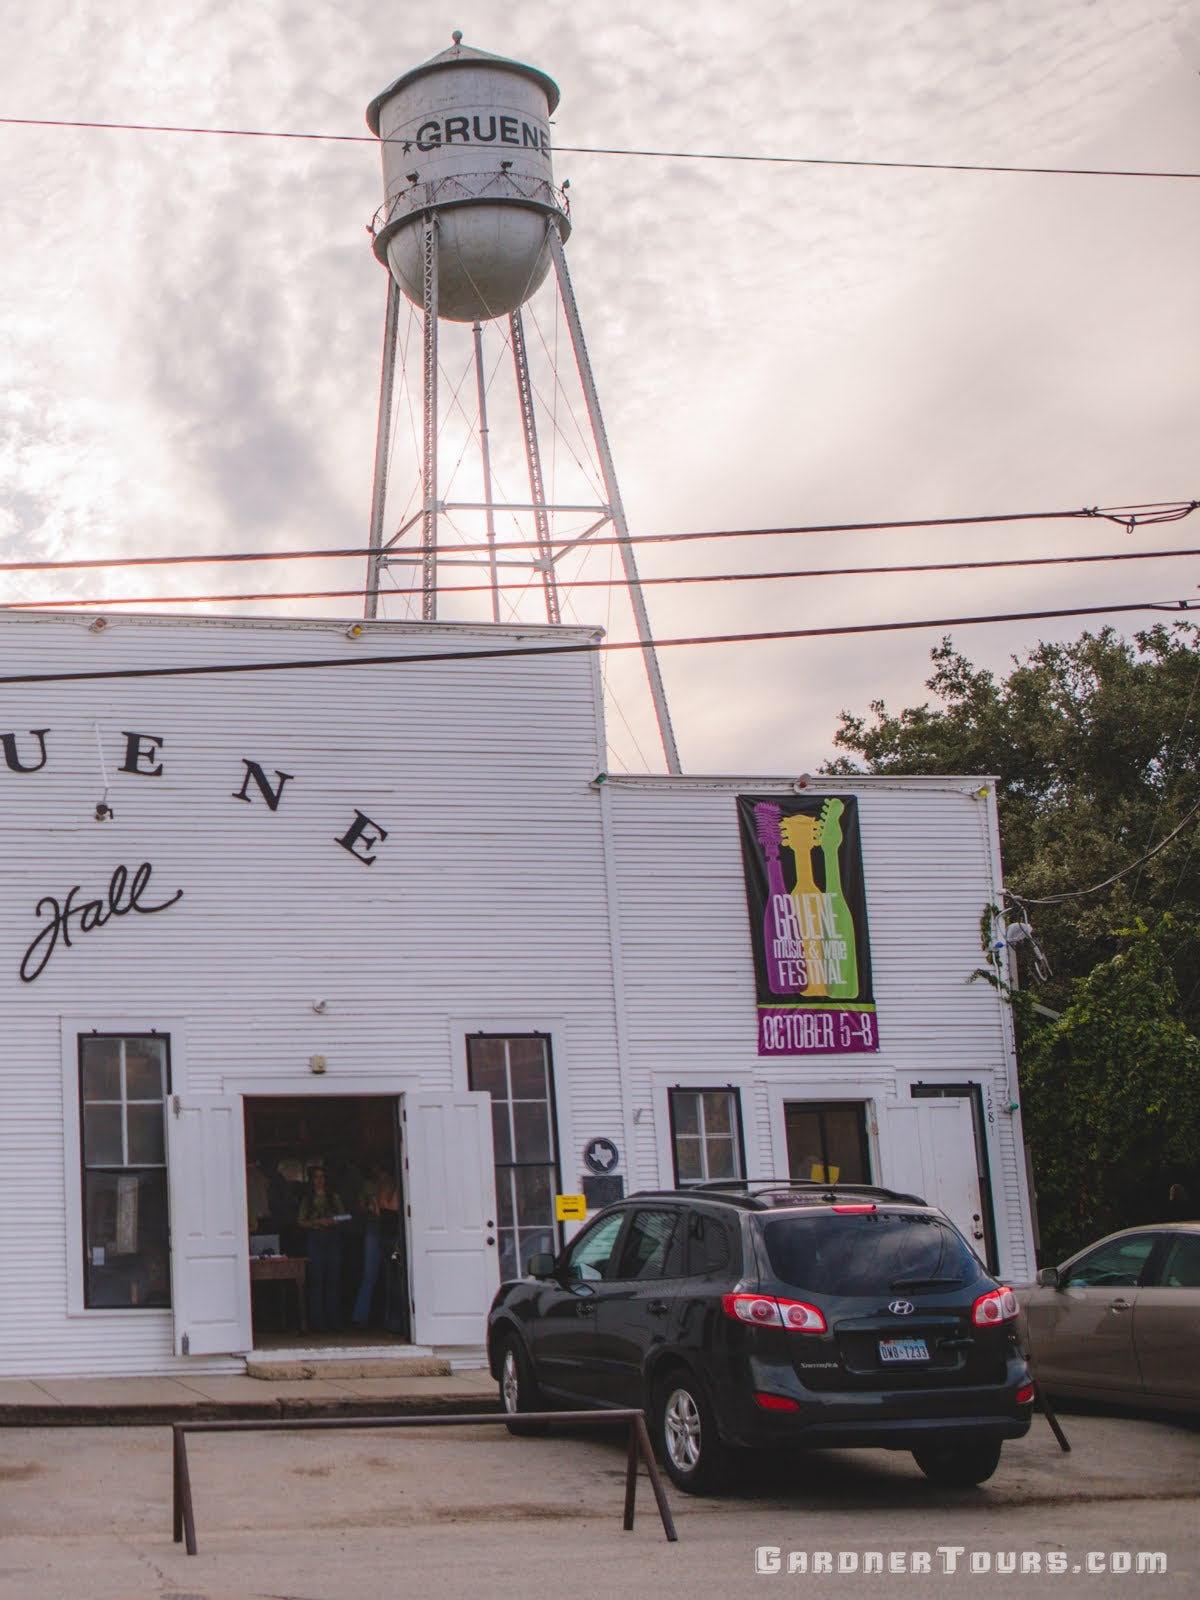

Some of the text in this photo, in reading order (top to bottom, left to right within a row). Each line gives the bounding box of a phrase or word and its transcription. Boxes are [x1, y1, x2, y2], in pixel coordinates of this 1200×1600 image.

[416, 115, 550, 160] GRUENE
[19, 862, 183, 982] Hall
[772, 892, 843, 940] GRUENE
[808, 940, 820, 959] &
[778, 959, 848, 987] FESTIVAL
[762, 1013, 835, 1050] OCTOBER
